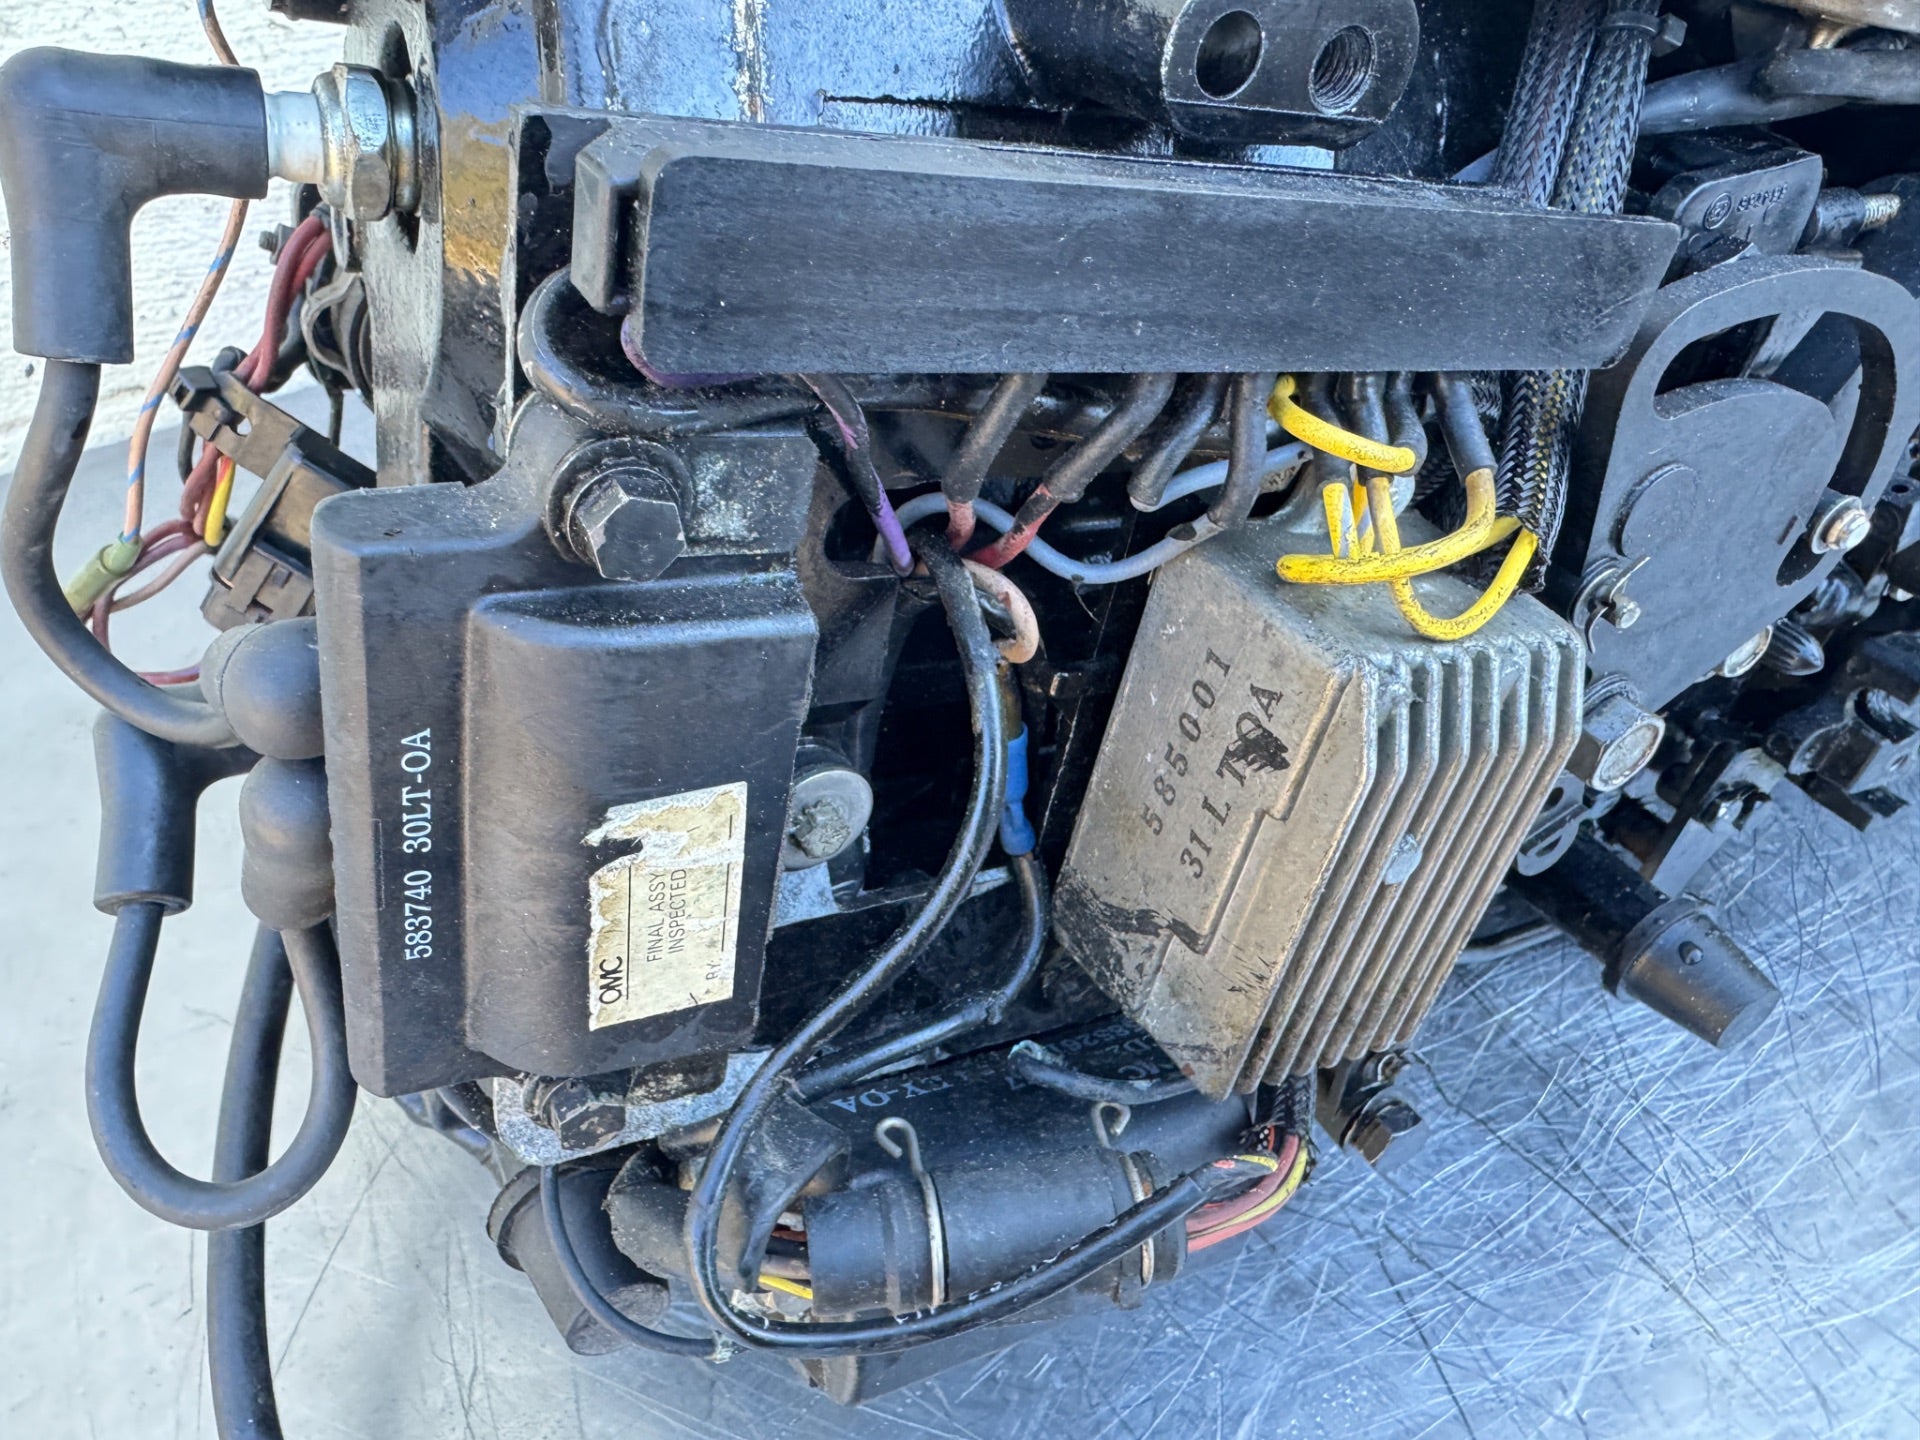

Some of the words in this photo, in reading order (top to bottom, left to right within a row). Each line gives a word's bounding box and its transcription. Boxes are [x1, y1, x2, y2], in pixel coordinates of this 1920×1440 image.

[1140, 648, 1231, 836] 585001
[404, 870, 433, 961] 583740
[648, 872, 666, 911] ASSY
[668, 868, 687, 954] INSPECTED
[646, 915, 665, 962] FINAL
[598, 955, 623, 1005] OMC
